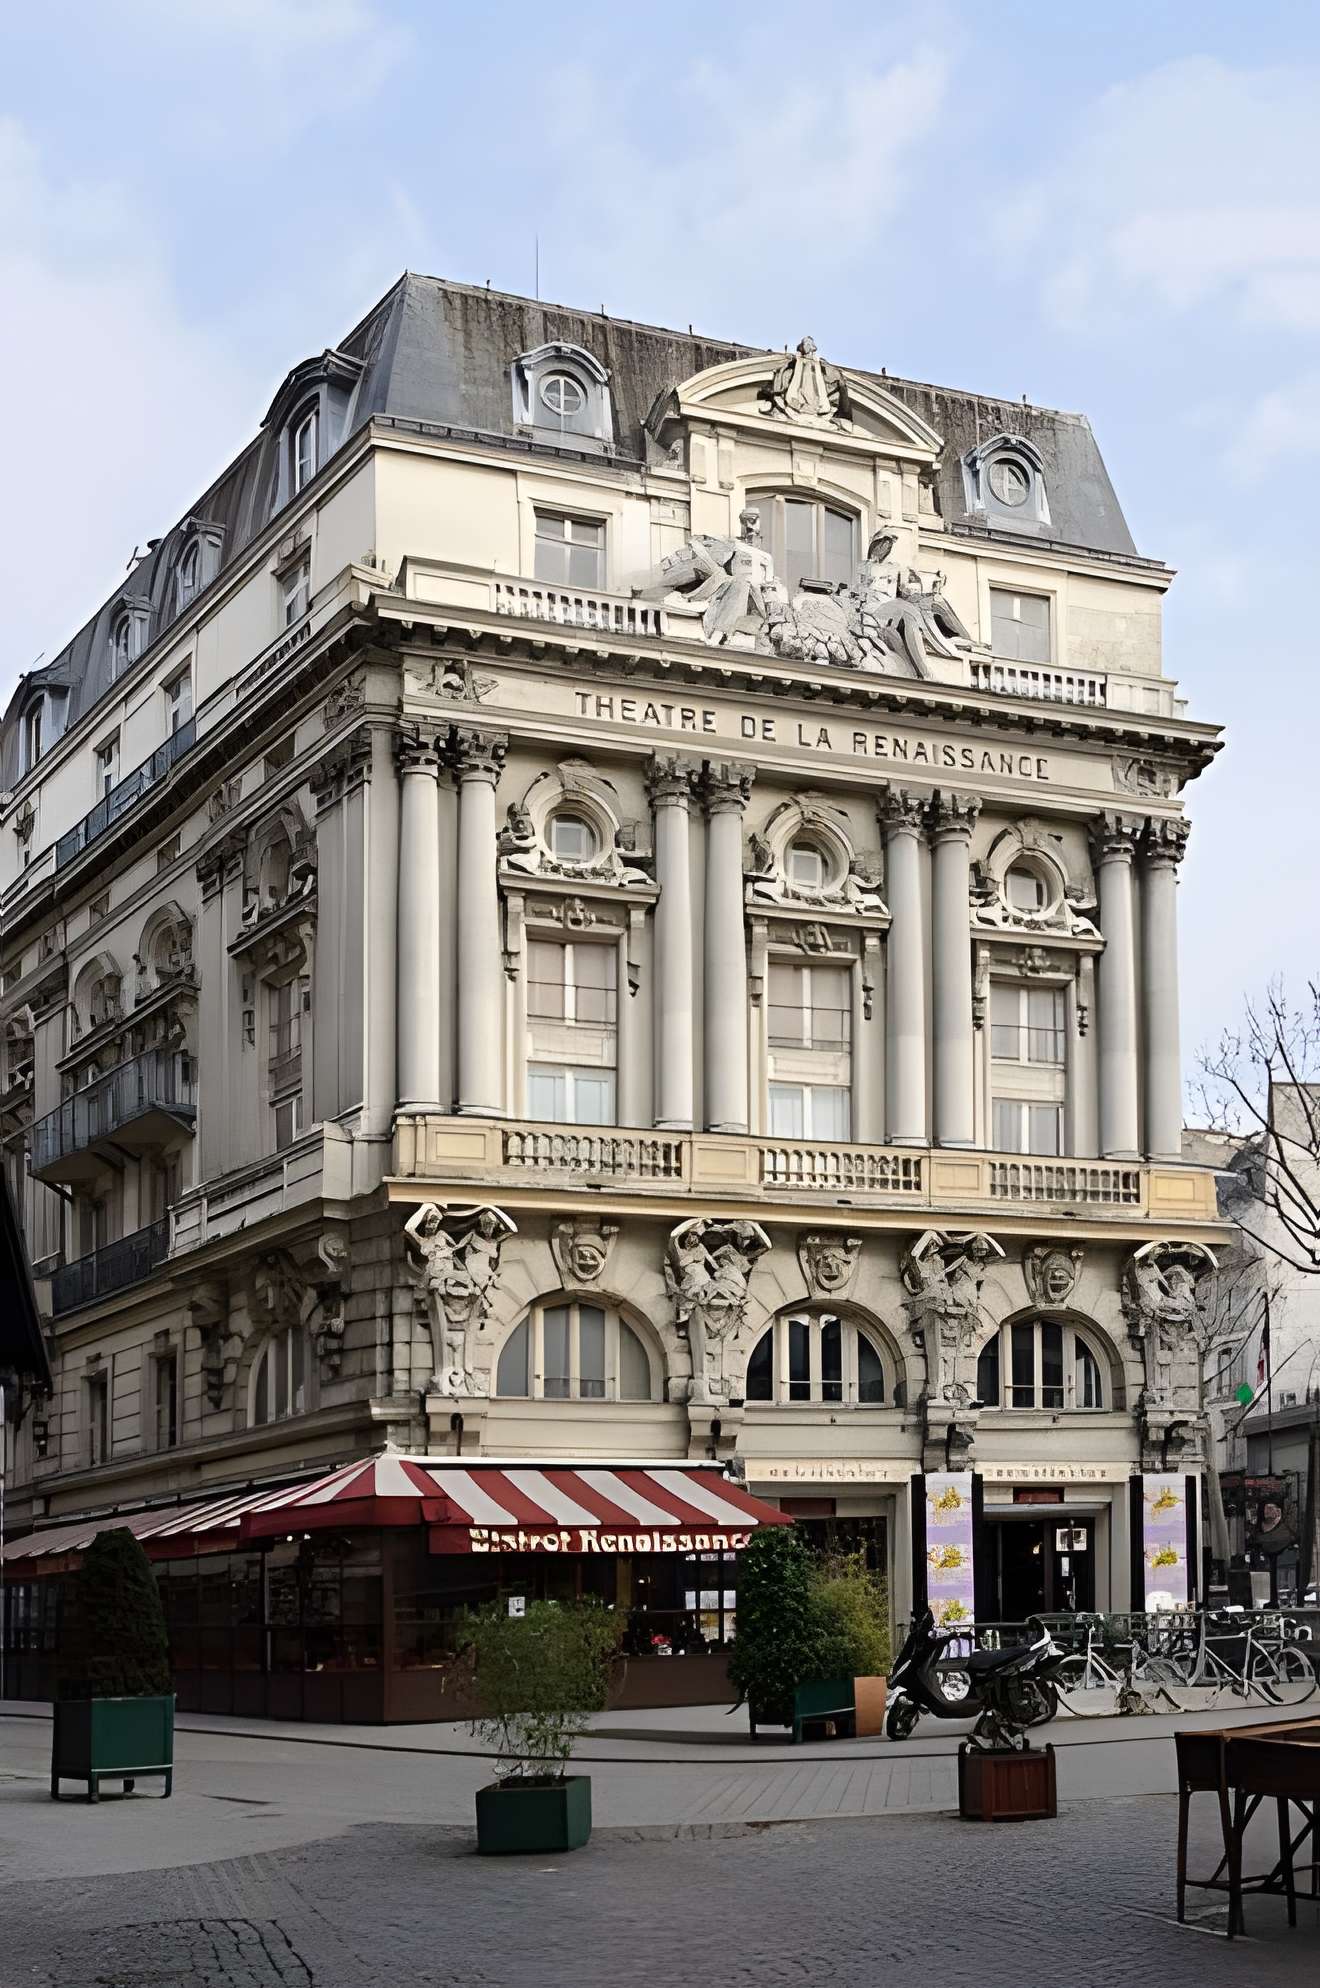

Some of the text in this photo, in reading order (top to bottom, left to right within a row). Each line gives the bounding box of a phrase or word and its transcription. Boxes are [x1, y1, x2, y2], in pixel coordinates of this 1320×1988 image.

[575, 692, 1050, 780] THEATRE DE LA RENAISSANCE
